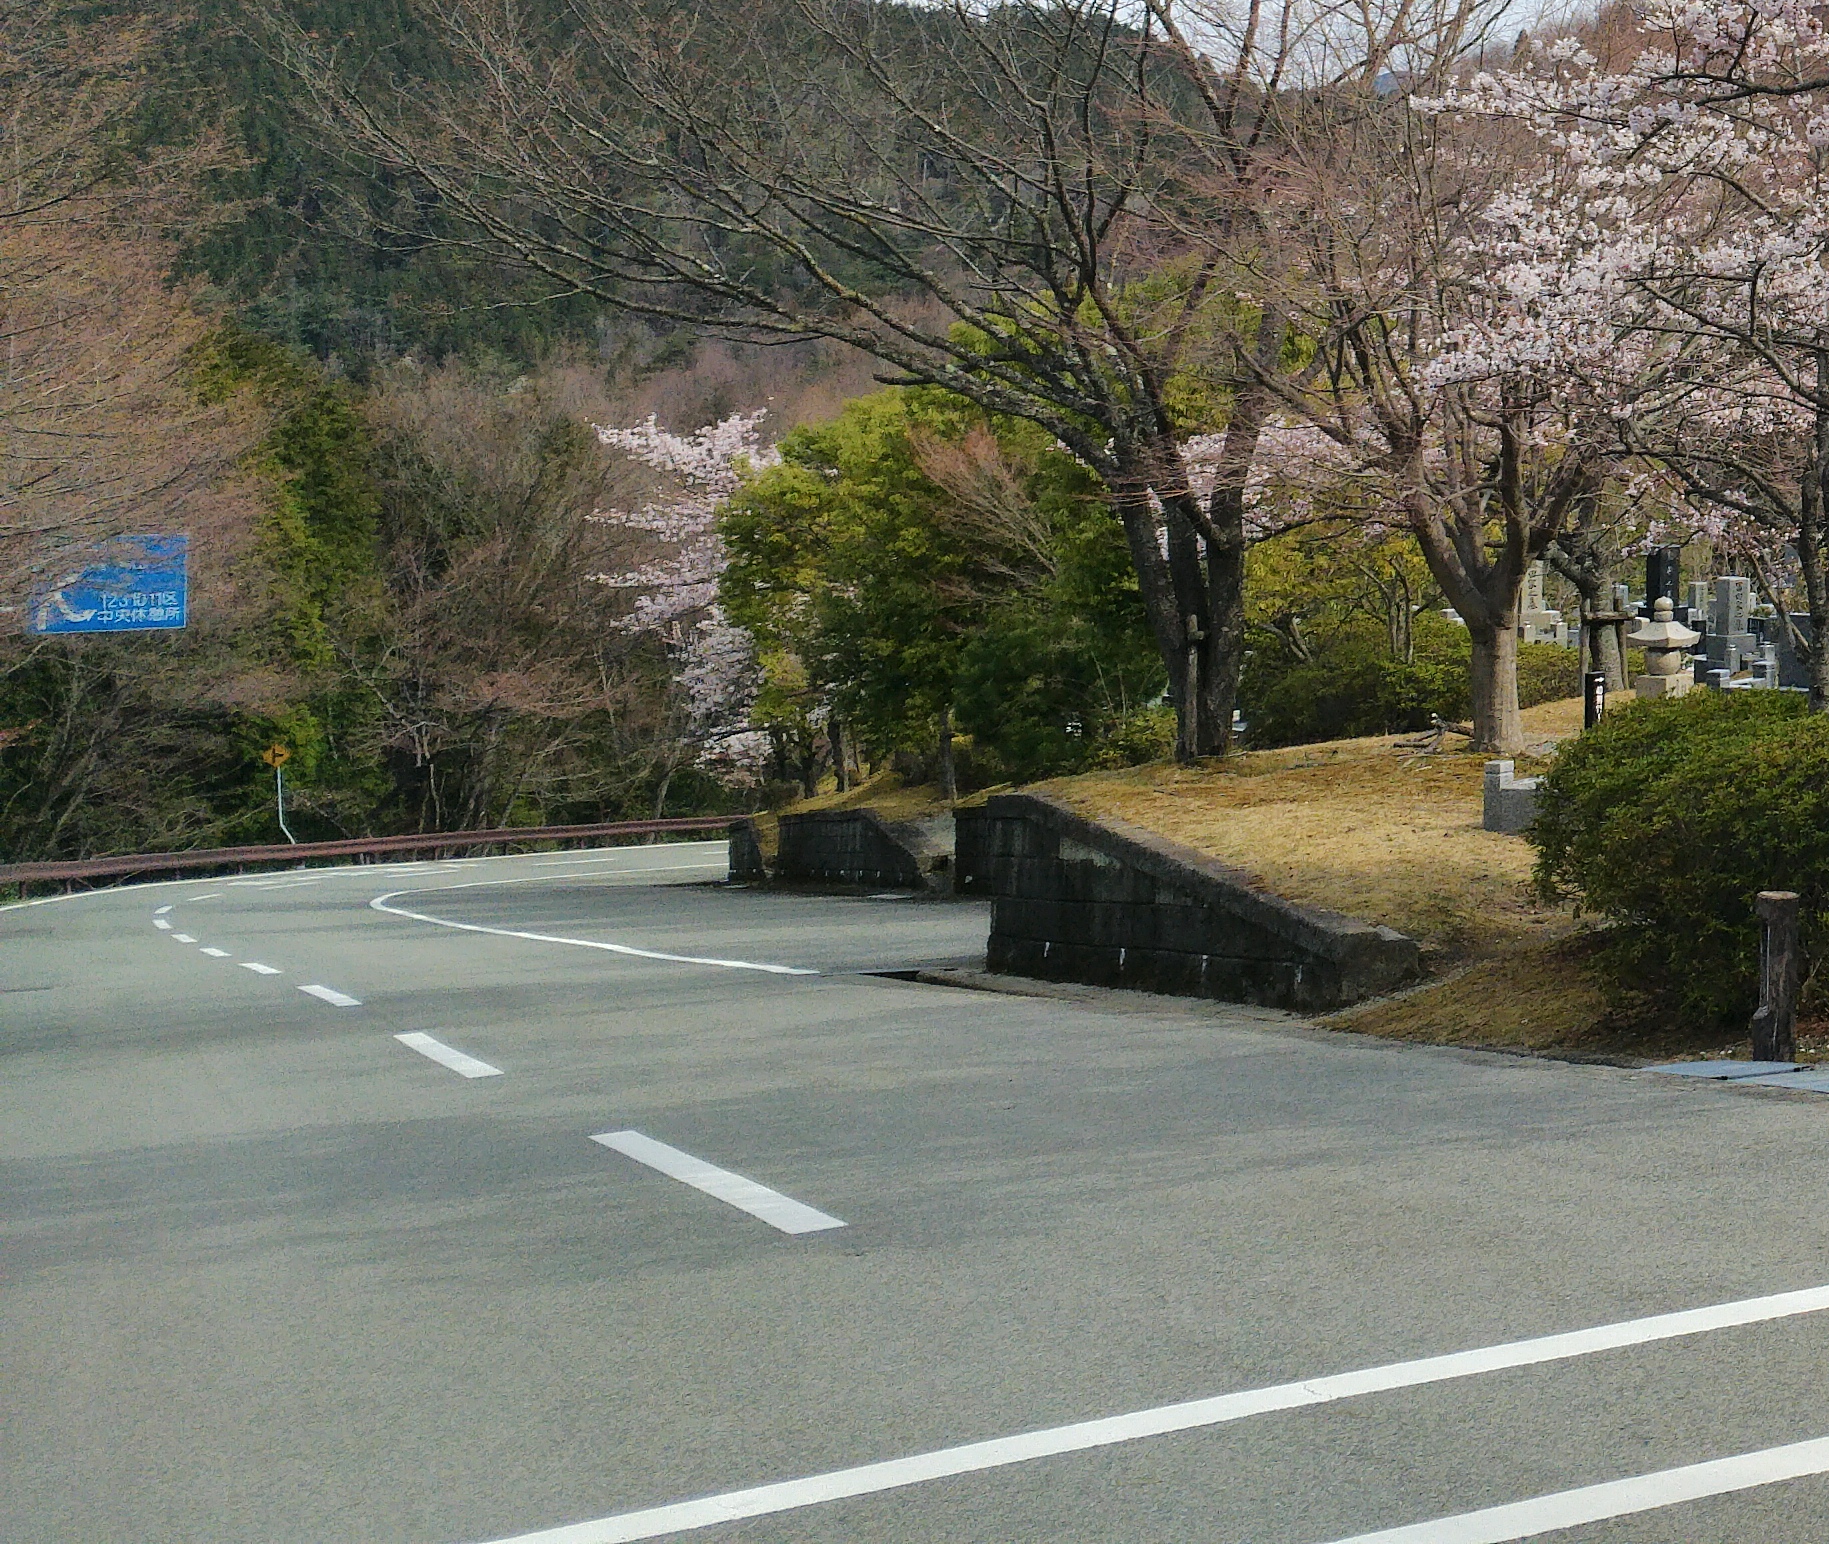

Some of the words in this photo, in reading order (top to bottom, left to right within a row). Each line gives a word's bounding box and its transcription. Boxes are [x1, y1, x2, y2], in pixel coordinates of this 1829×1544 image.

[98, 606, 180, 624] 中央休憩所
